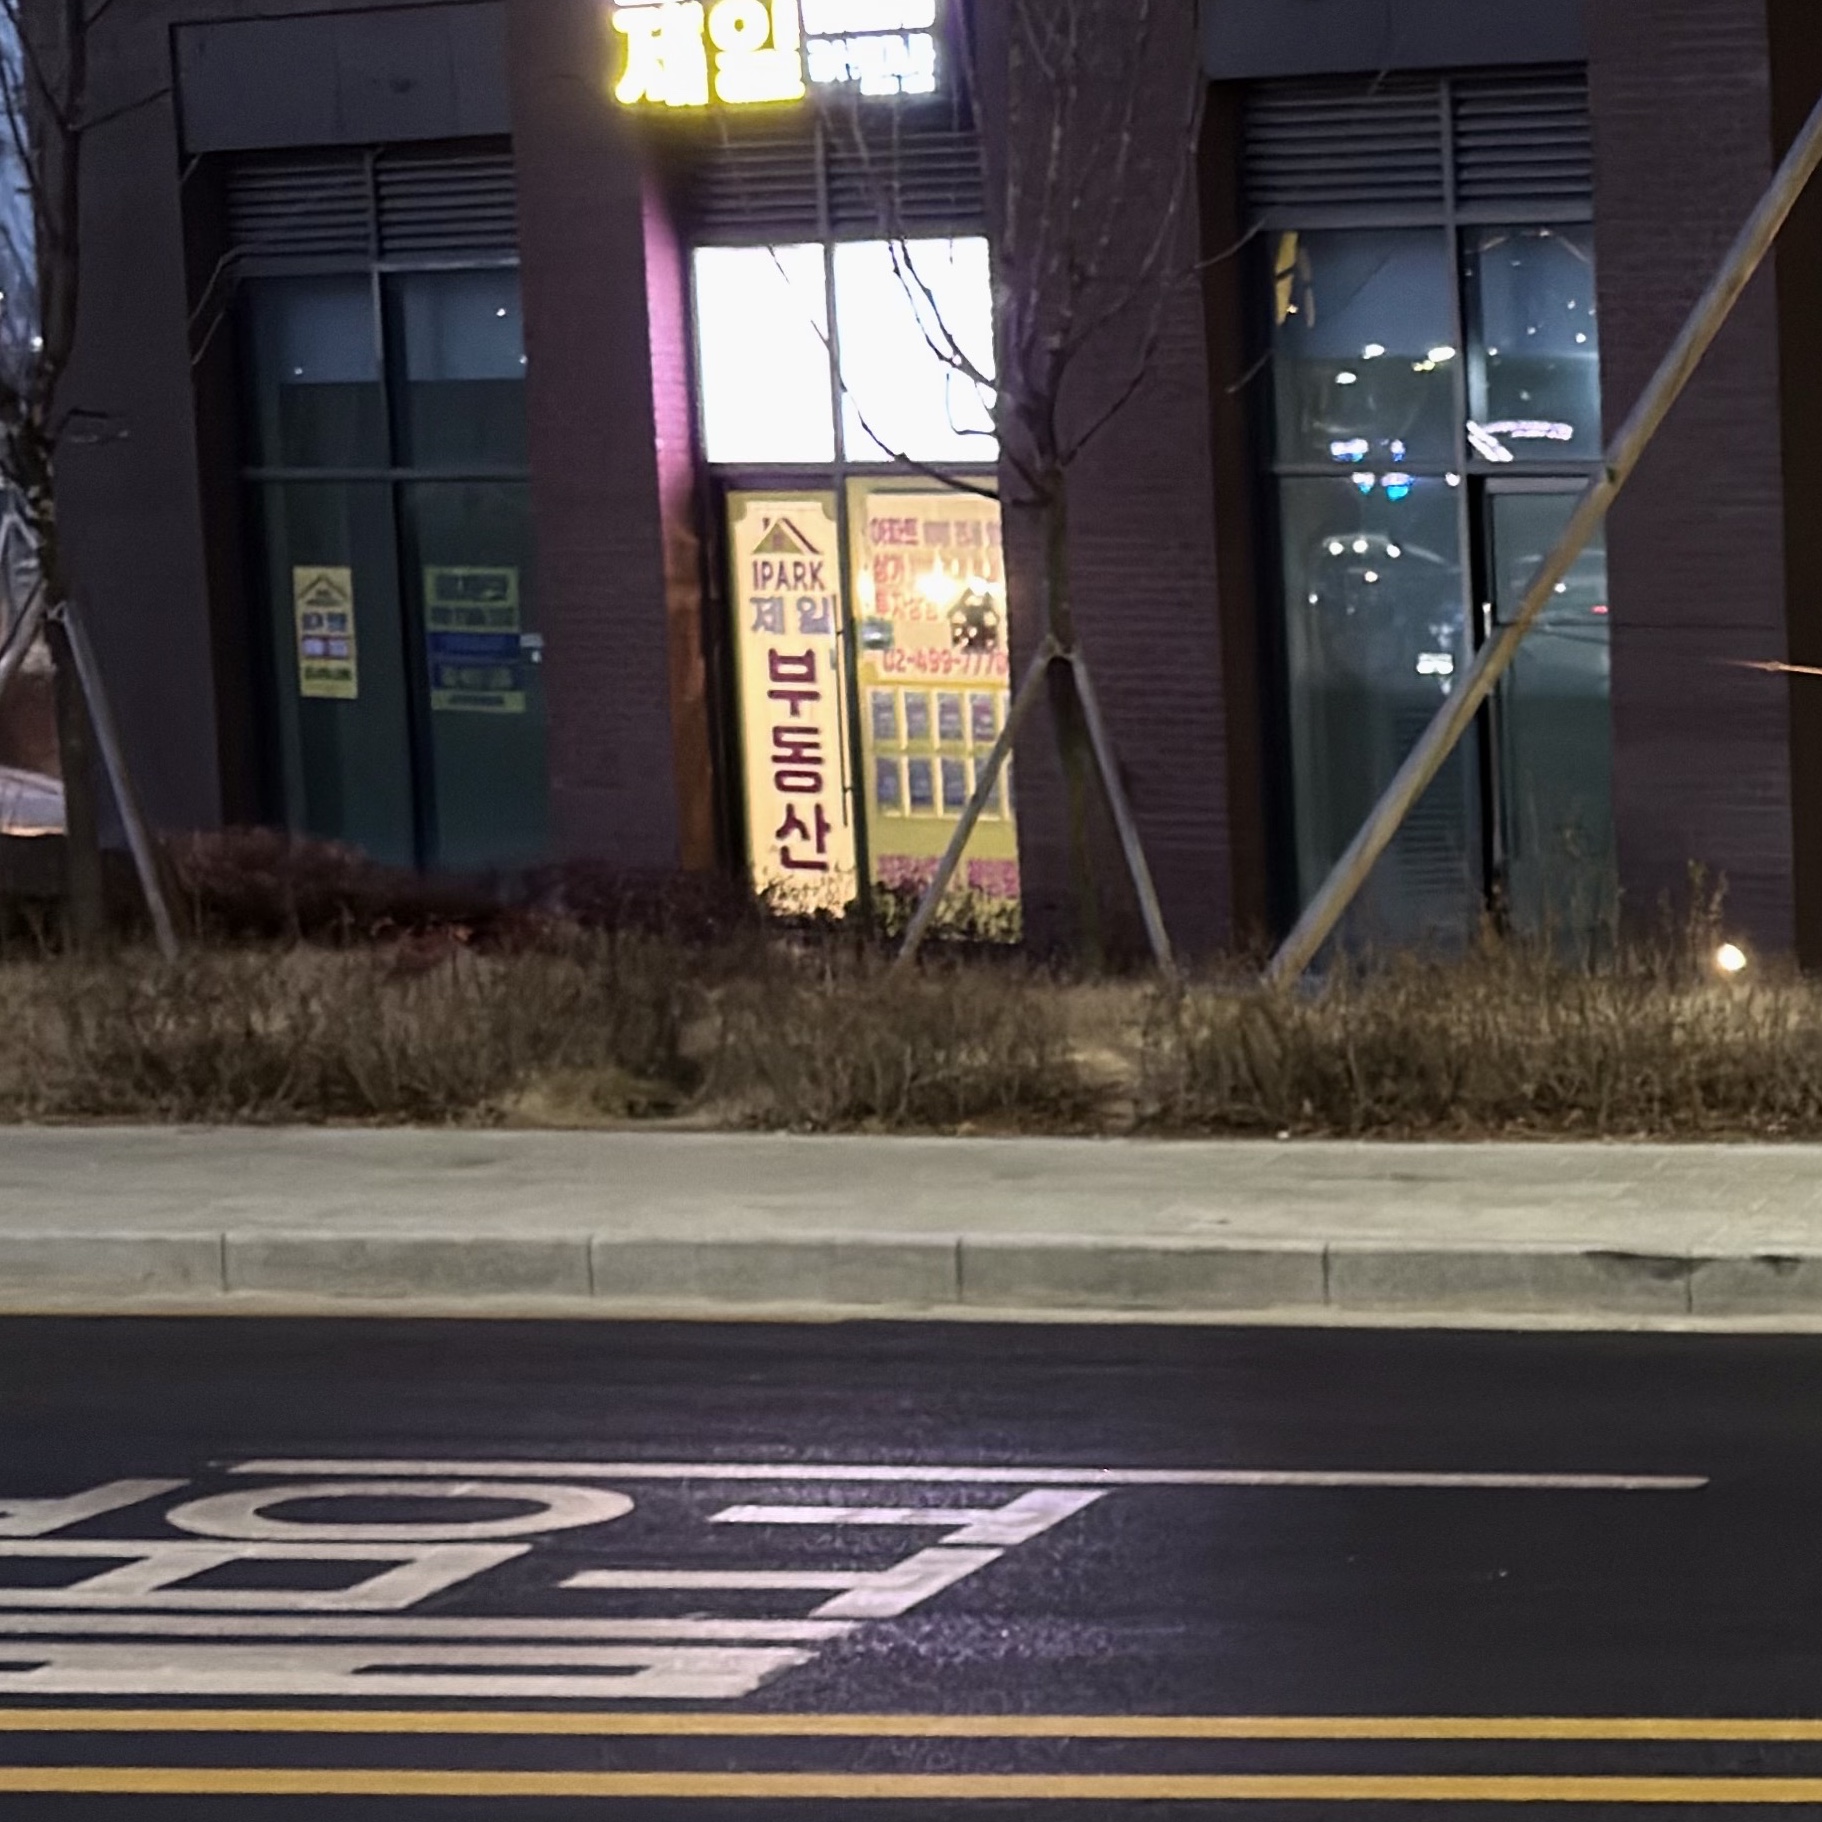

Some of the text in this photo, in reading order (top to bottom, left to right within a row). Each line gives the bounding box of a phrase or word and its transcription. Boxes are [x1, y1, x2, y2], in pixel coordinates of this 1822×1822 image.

[752, 561, 826, 591] IPARK
[750, 596, 830, 635] 제일
[766, 648, 831, 871] 부동산
